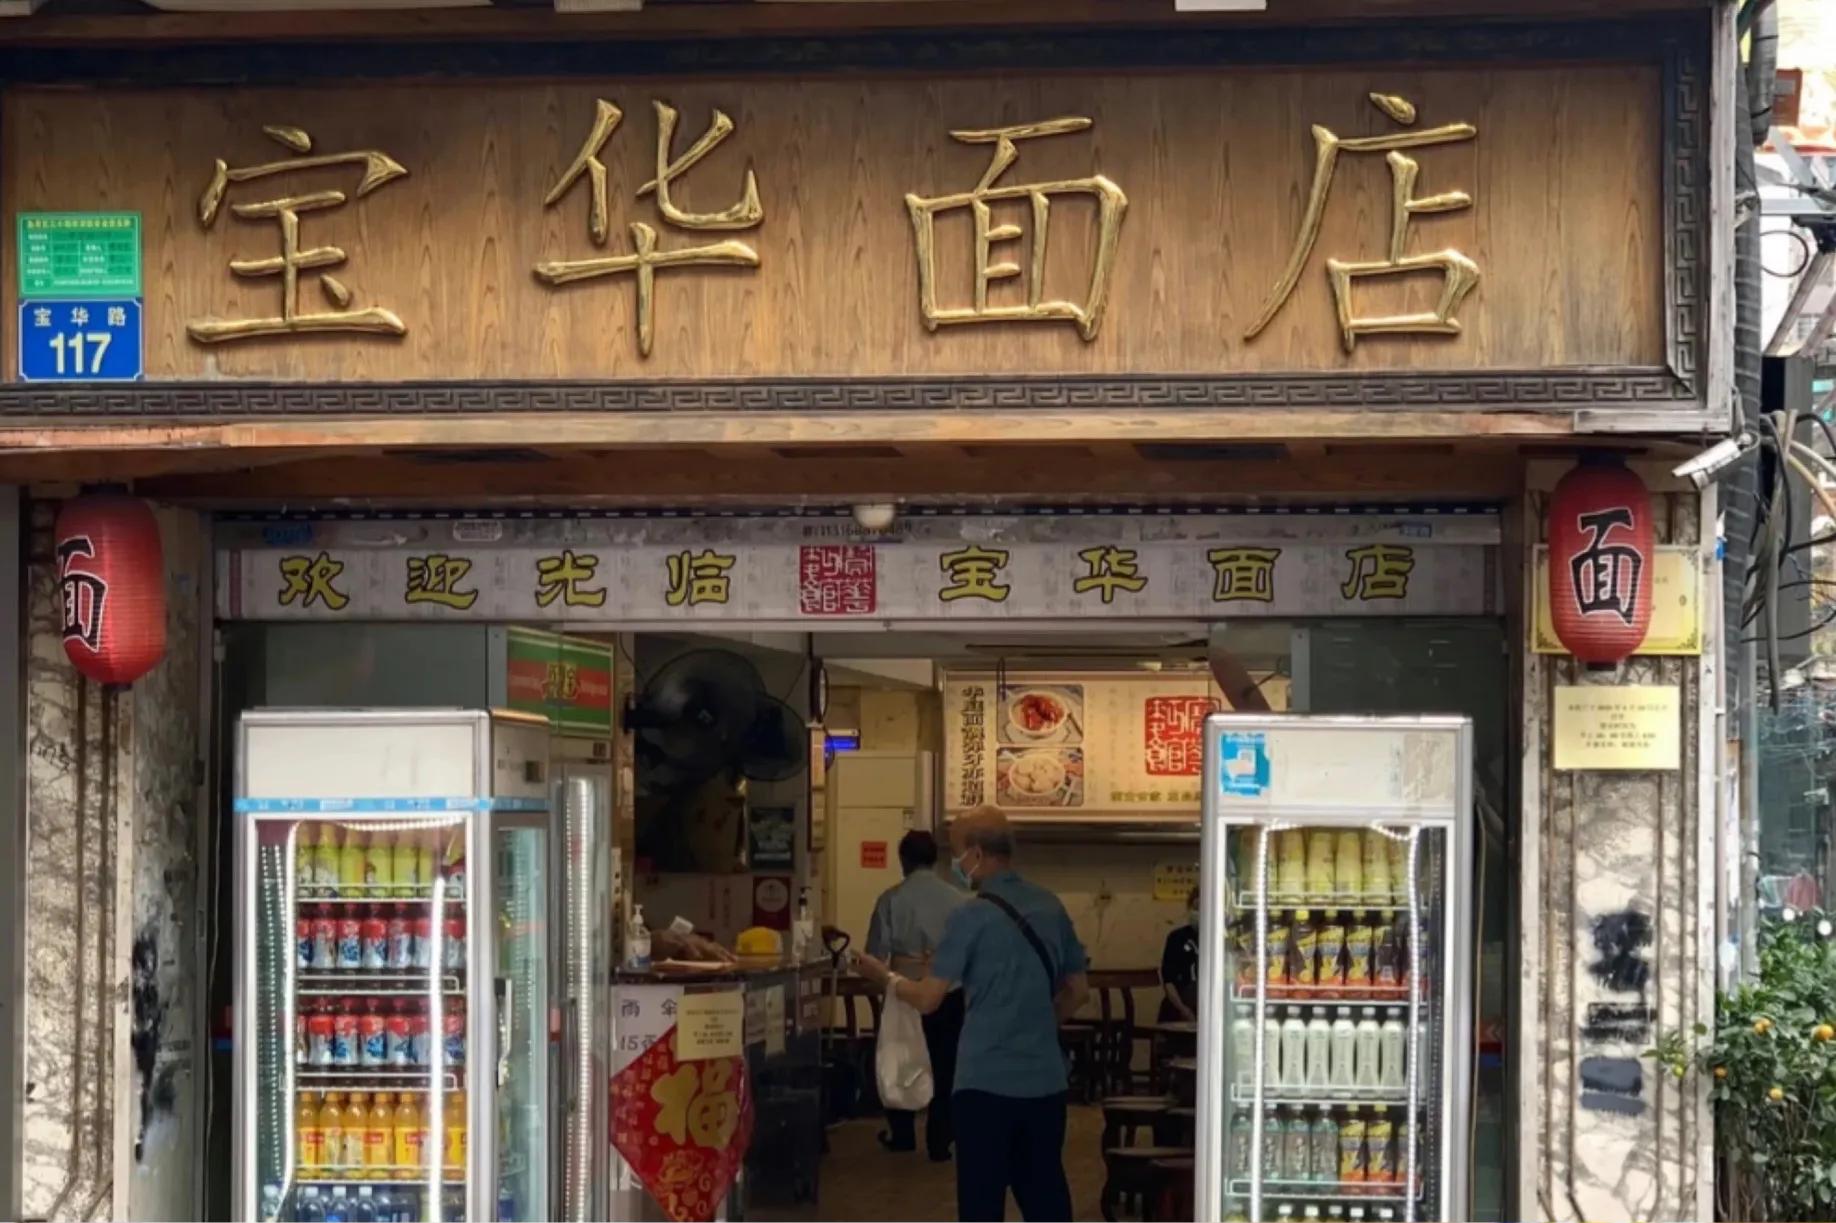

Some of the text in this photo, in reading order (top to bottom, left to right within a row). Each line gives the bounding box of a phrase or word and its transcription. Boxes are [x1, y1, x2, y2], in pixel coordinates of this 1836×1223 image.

[187, 94, 1480, 357] 宝华面店
[34, 306, 126, 327] 宝华路
[50, 332, 112, 374] 117
[57, 535, 108, 653] 面
[278, 551, 736, 609] 欢迎光临
[939, 545, 1416, 602] 宝华面店
[1570, 507, 1642, 625] 面
